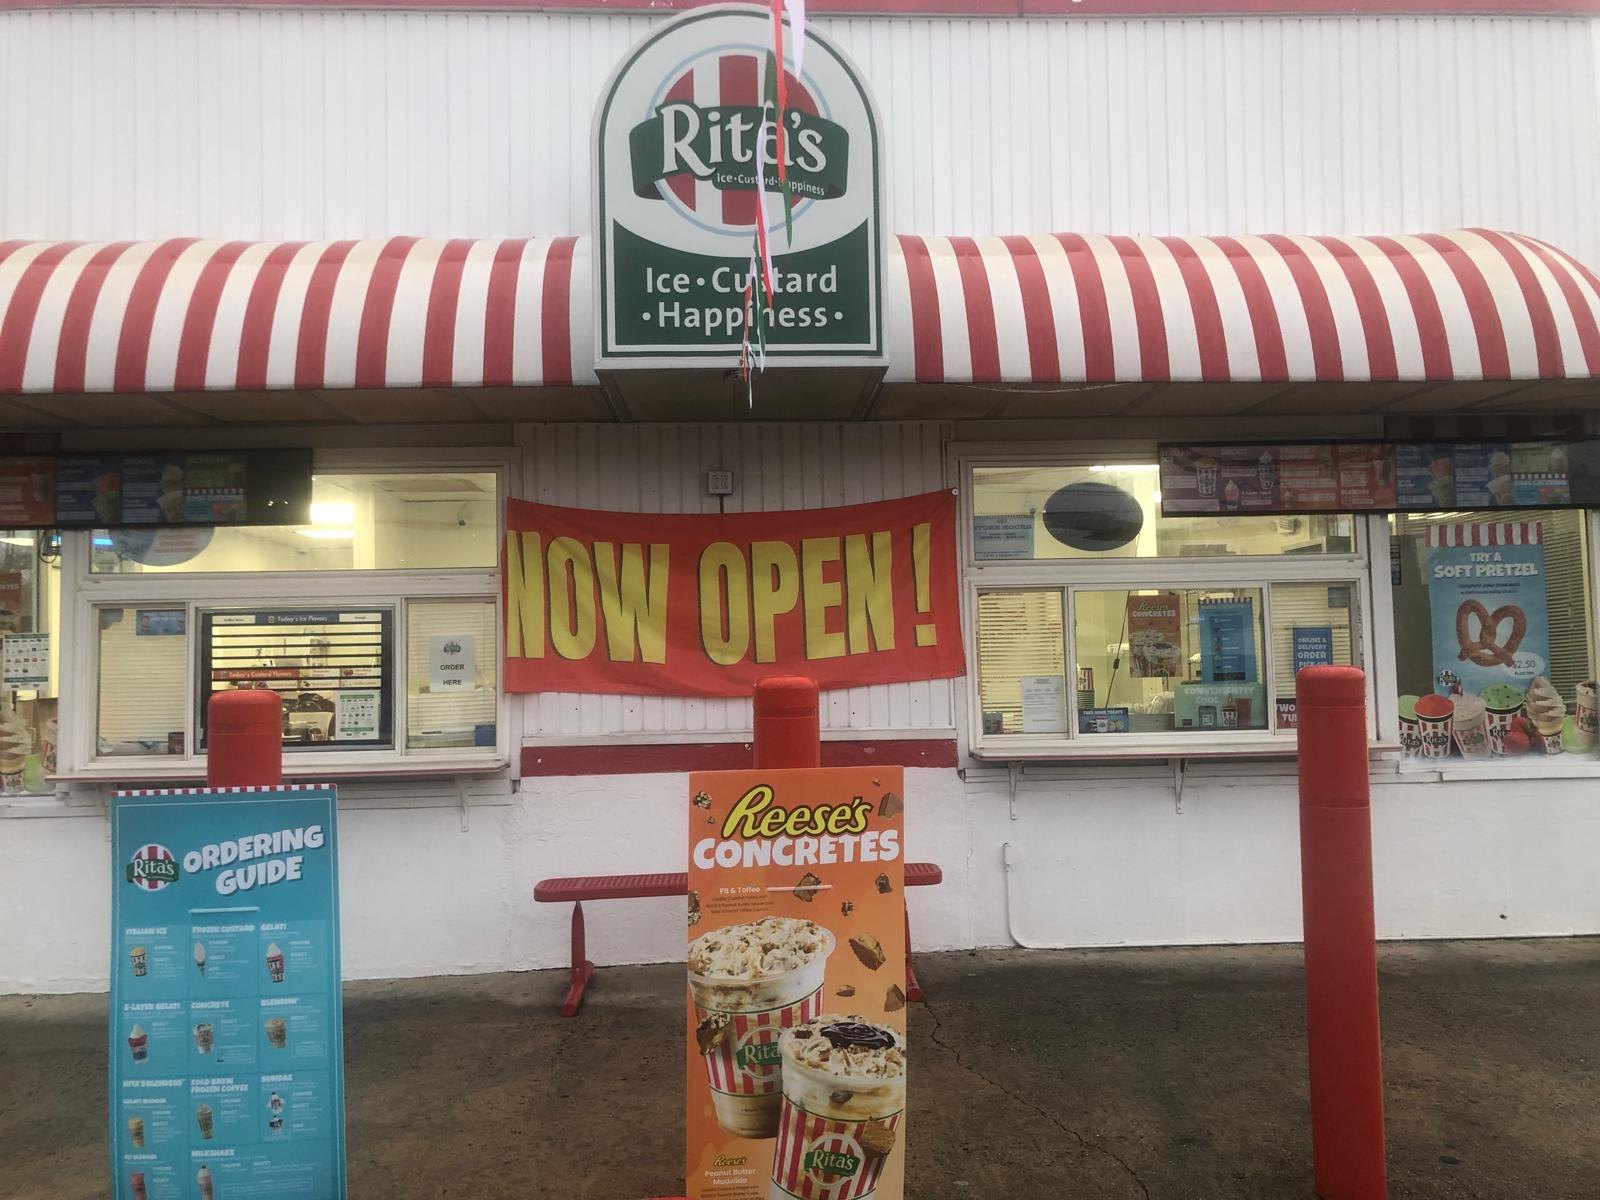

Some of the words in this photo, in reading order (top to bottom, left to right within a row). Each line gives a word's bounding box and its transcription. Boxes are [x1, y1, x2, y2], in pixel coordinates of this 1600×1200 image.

[660, 103, 827, 177] Rita's
[717, 173, 733, 183] Ice
[738, 174, 775, 186] Custrd
[646, 267, 690, 293] Ice
[659, 302, 827, 336] Happiness
[1469, 553, 1489, 562] TRY
[1493, 552, 1502, 561] A
[1434, 564, 1473, 578] SOFT
[1475, 563, 1539, 577] PRETZEL
[506, 529, 670, 664] NOW
[698, 530, 896, 666] OPEN
[1297, 651, 1327, 659] ORDER
[721, 784, 873, 839] Reese's
[183, 825, 325, 873] ORDERING
[693, 829, 900, 870] CONCRETES
[133, 859, 175, 877] Rita's
[215, 855, 303, 895] GUIDE
[260, 923, 287, 931] GELATI
[812, 1149, 854, 1170] Rita's
[713, 1177, 748, 1185] Mudslide
